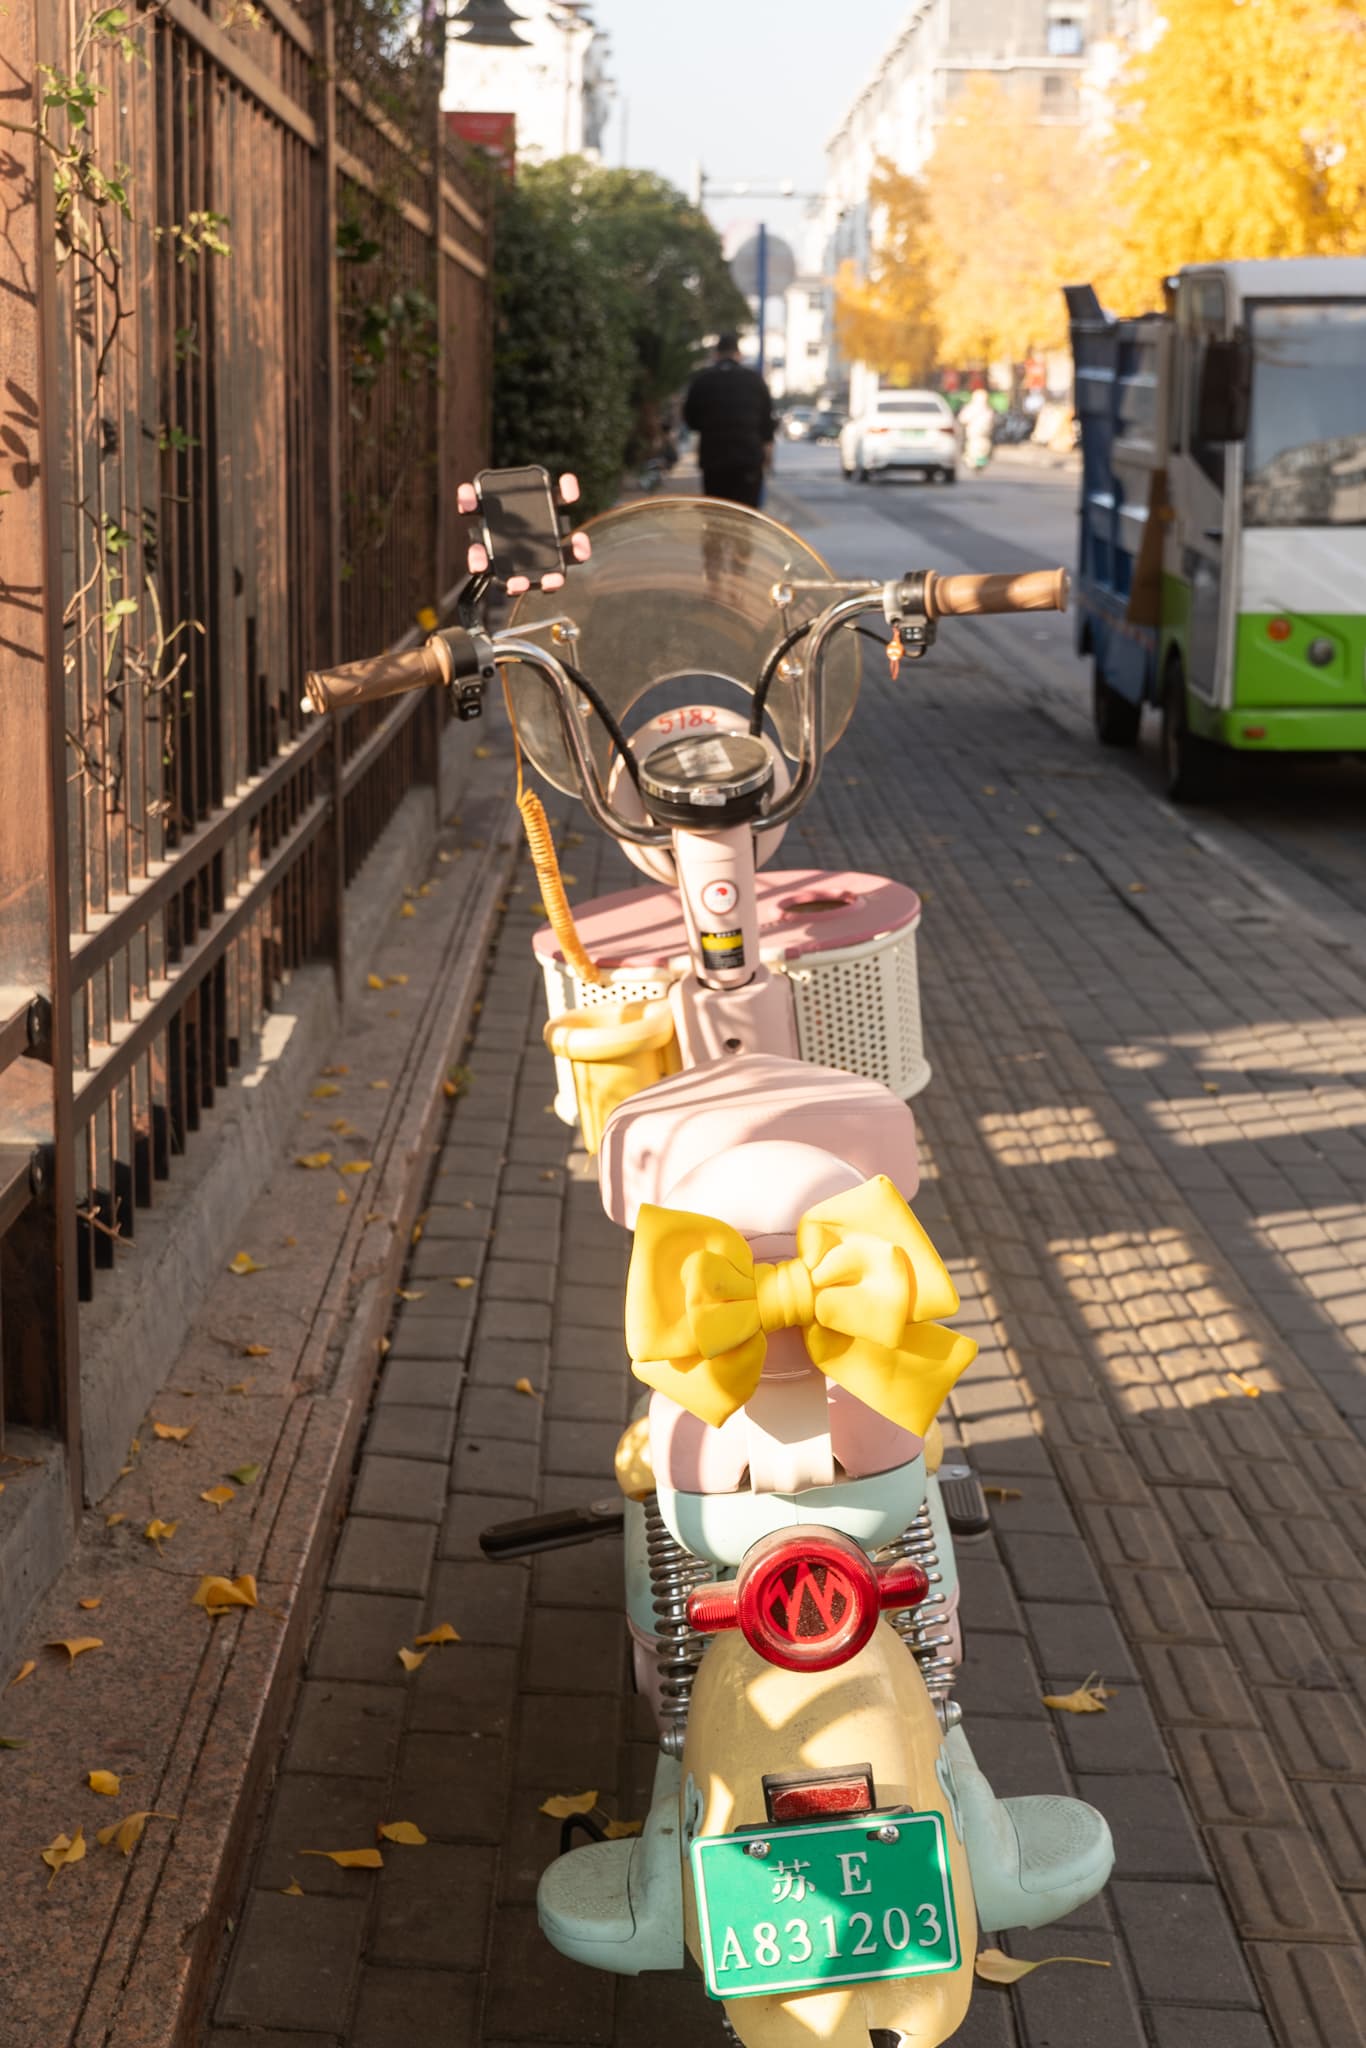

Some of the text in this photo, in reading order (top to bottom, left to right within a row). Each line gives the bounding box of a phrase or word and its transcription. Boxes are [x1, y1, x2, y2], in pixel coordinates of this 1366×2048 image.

[768, 1851, 872, 1904] 苏 E
[717, 1903, 942, 1972] A831203
